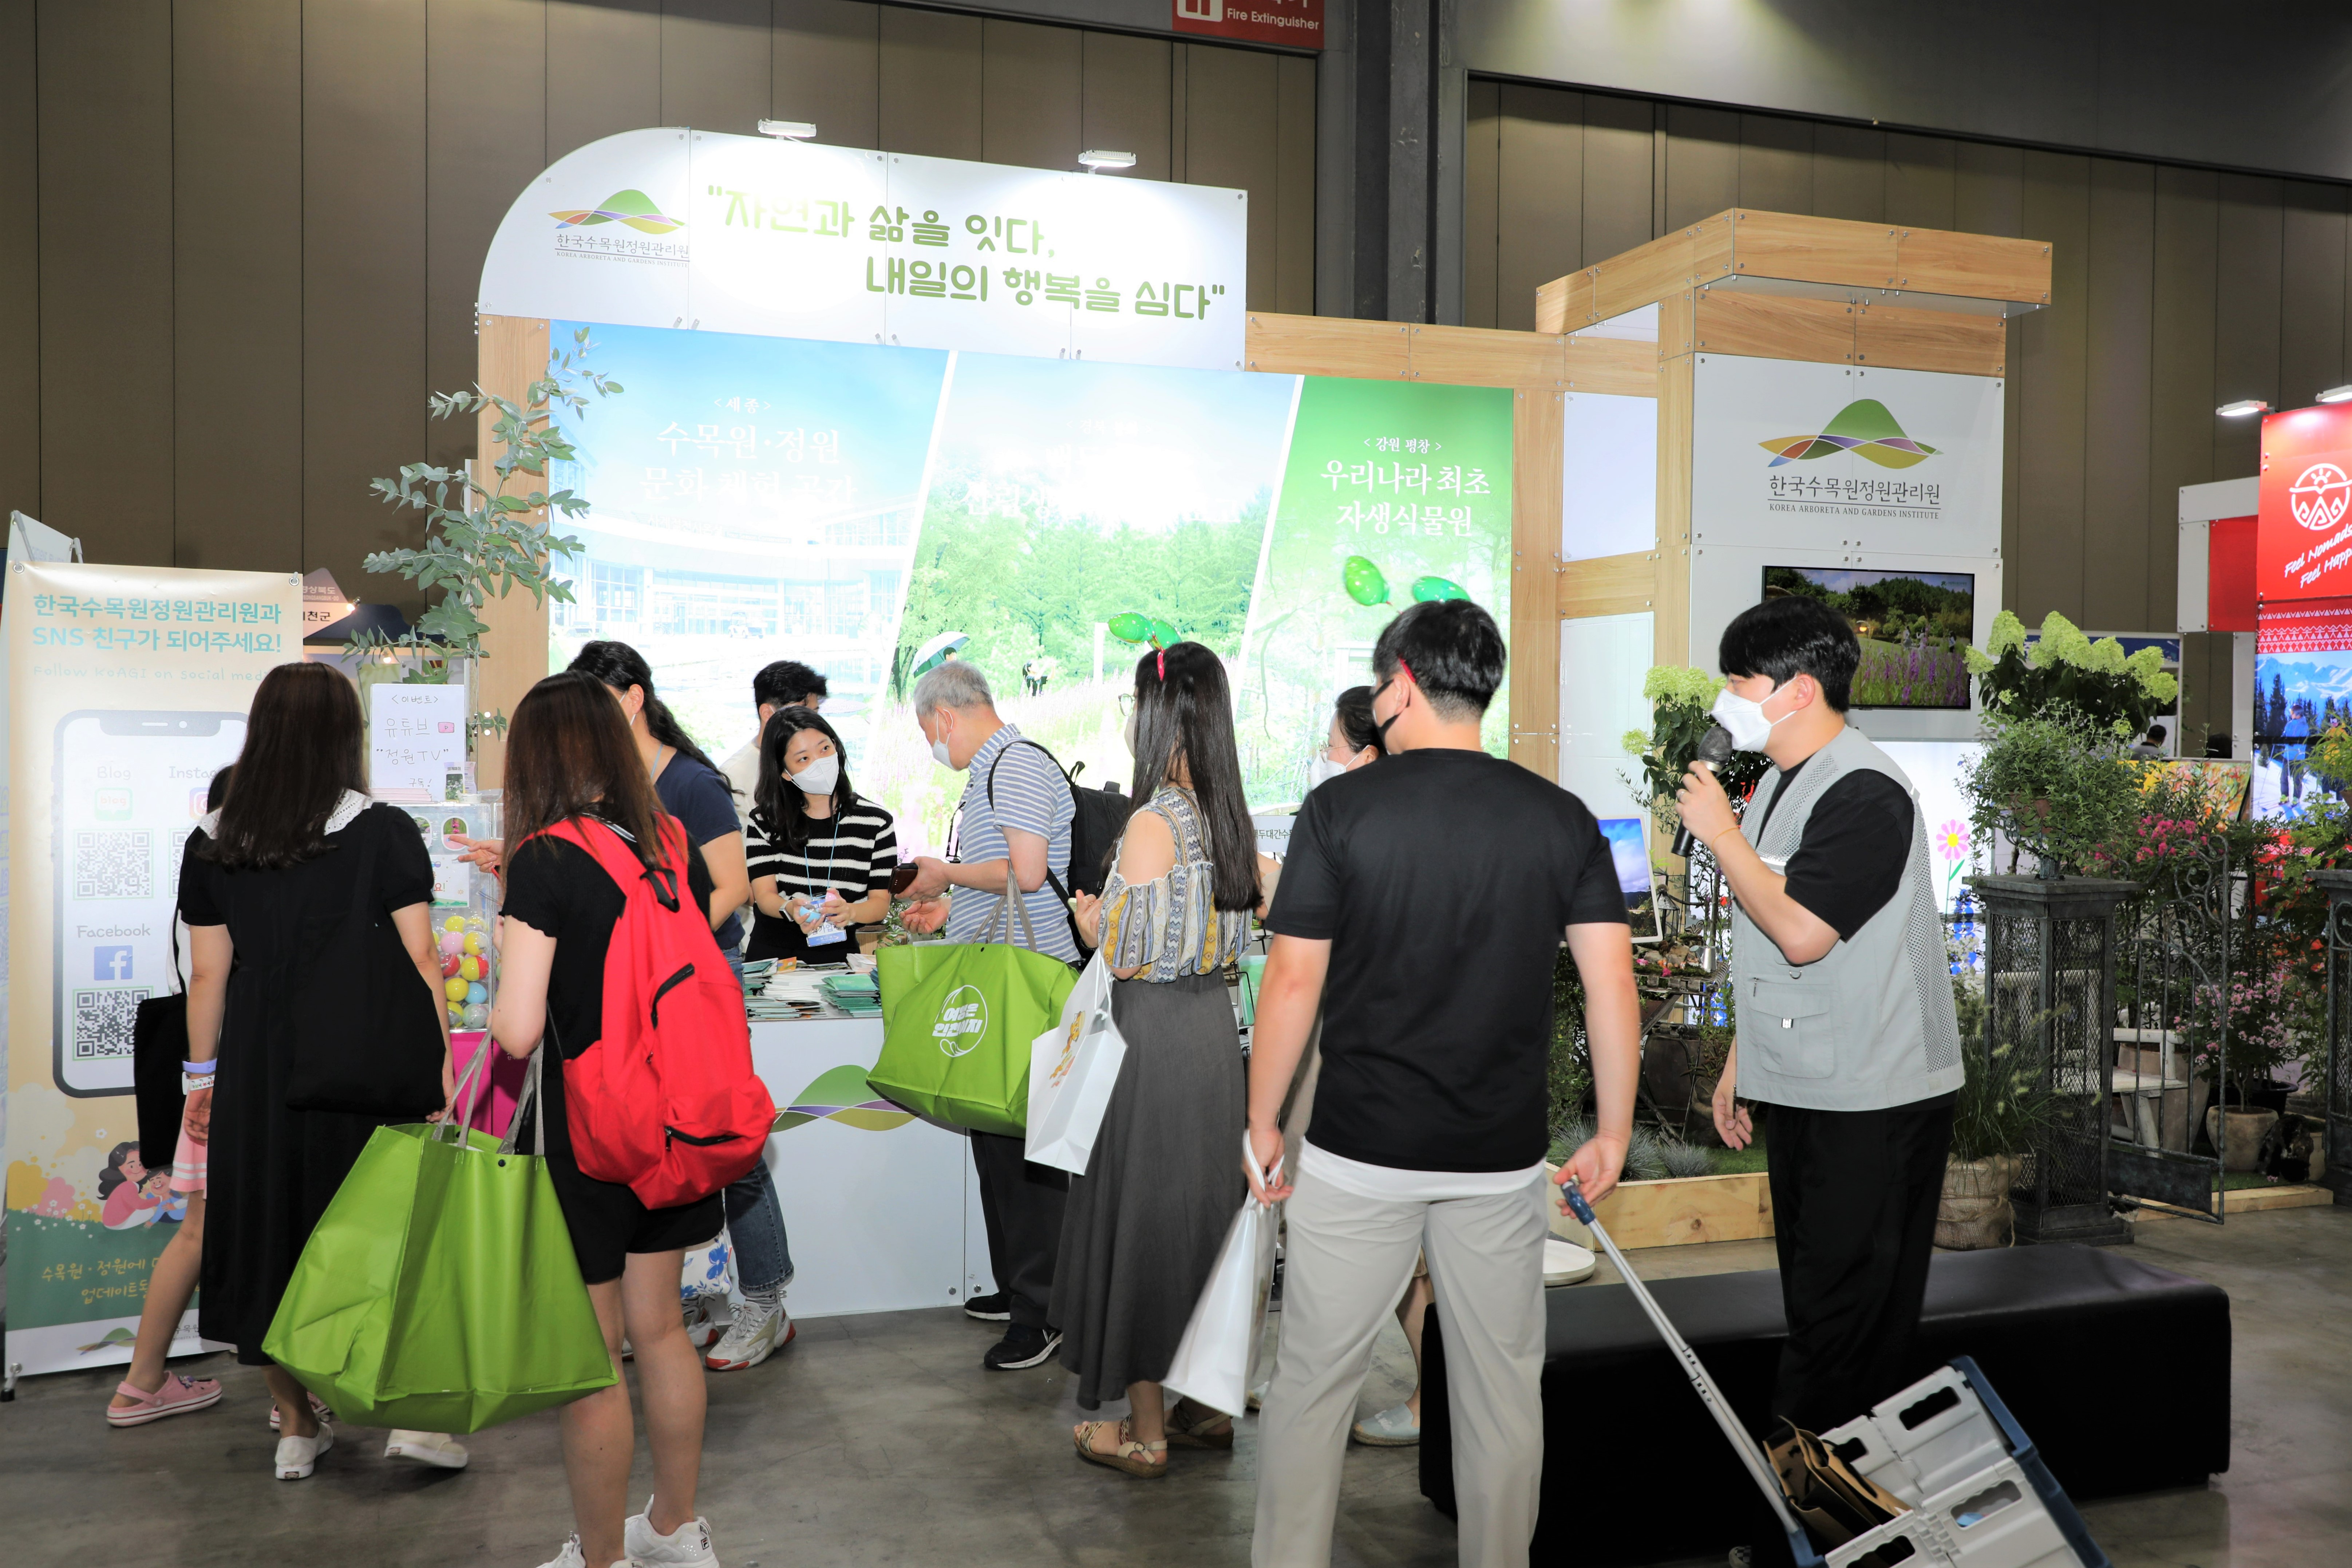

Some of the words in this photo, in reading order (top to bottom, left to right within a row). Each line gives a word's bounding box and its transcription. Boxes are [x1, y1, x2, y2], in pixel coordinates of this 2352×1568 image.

[1227, 8, 1248, 20] Fire
[1251, 11, 1319, 30] Extinguisher
[708, 185, 855, 238] "자연과
[870, 205, 950, 247] 삶을
[965, 214, 1055, 258] 잇다,
[556, 234, 689, 258] 한국수목원정원관리원
[579, 253, 611, 261] ARBORETA
[866, 256, 988, 301] 내일의
[1003, 267, 1121, 312] 행복을
[1134, 281, 1225, 320] 심다"
[1375, 437, 1400, 452] 강원
[1405, 439, 1430, 454] 평창
[639, 466, 709, 503] 문화
[1320, 460, 1432, 495] 우리나라
[1436, 465, 1491, 498] 최초
[1770, 475, 1940, 505] 한국수목원정원관리원
[1336, 500, 1473, 537] 자생식물원
[1770, 503, 1796, 512] KOREA
[1799, 505, 1840, 514] ARBORETA
[1862, 508, 1897, 517] GARDENS
[1899, 510, 1939, 519] INSTITUTE
[2284, 552, 2305, 578] Feel
[2300, 563, 2321, 589] Feel
[33, 594, 281, 624] 한국수목원정원관리원과
[32, 627, 84, 647] SNS
[92, 627, 160, 651] 친구가
[166, 629, 281, 654] 되어주세요!
[34, 663, 87, 677] Follow
[95, 667, 147, 679] KoAGI
[154, 671, 173, 679] on
[384, 718, 430, 738] 유튜브
[97, 766, 131, 781] Blog
[100, 796, 126, 806] blog
[76, 924, 151, 938] Facebook
[42, 1263, 83, 1282] 수목원
[97, 1258, 145, 1276] 정원에
